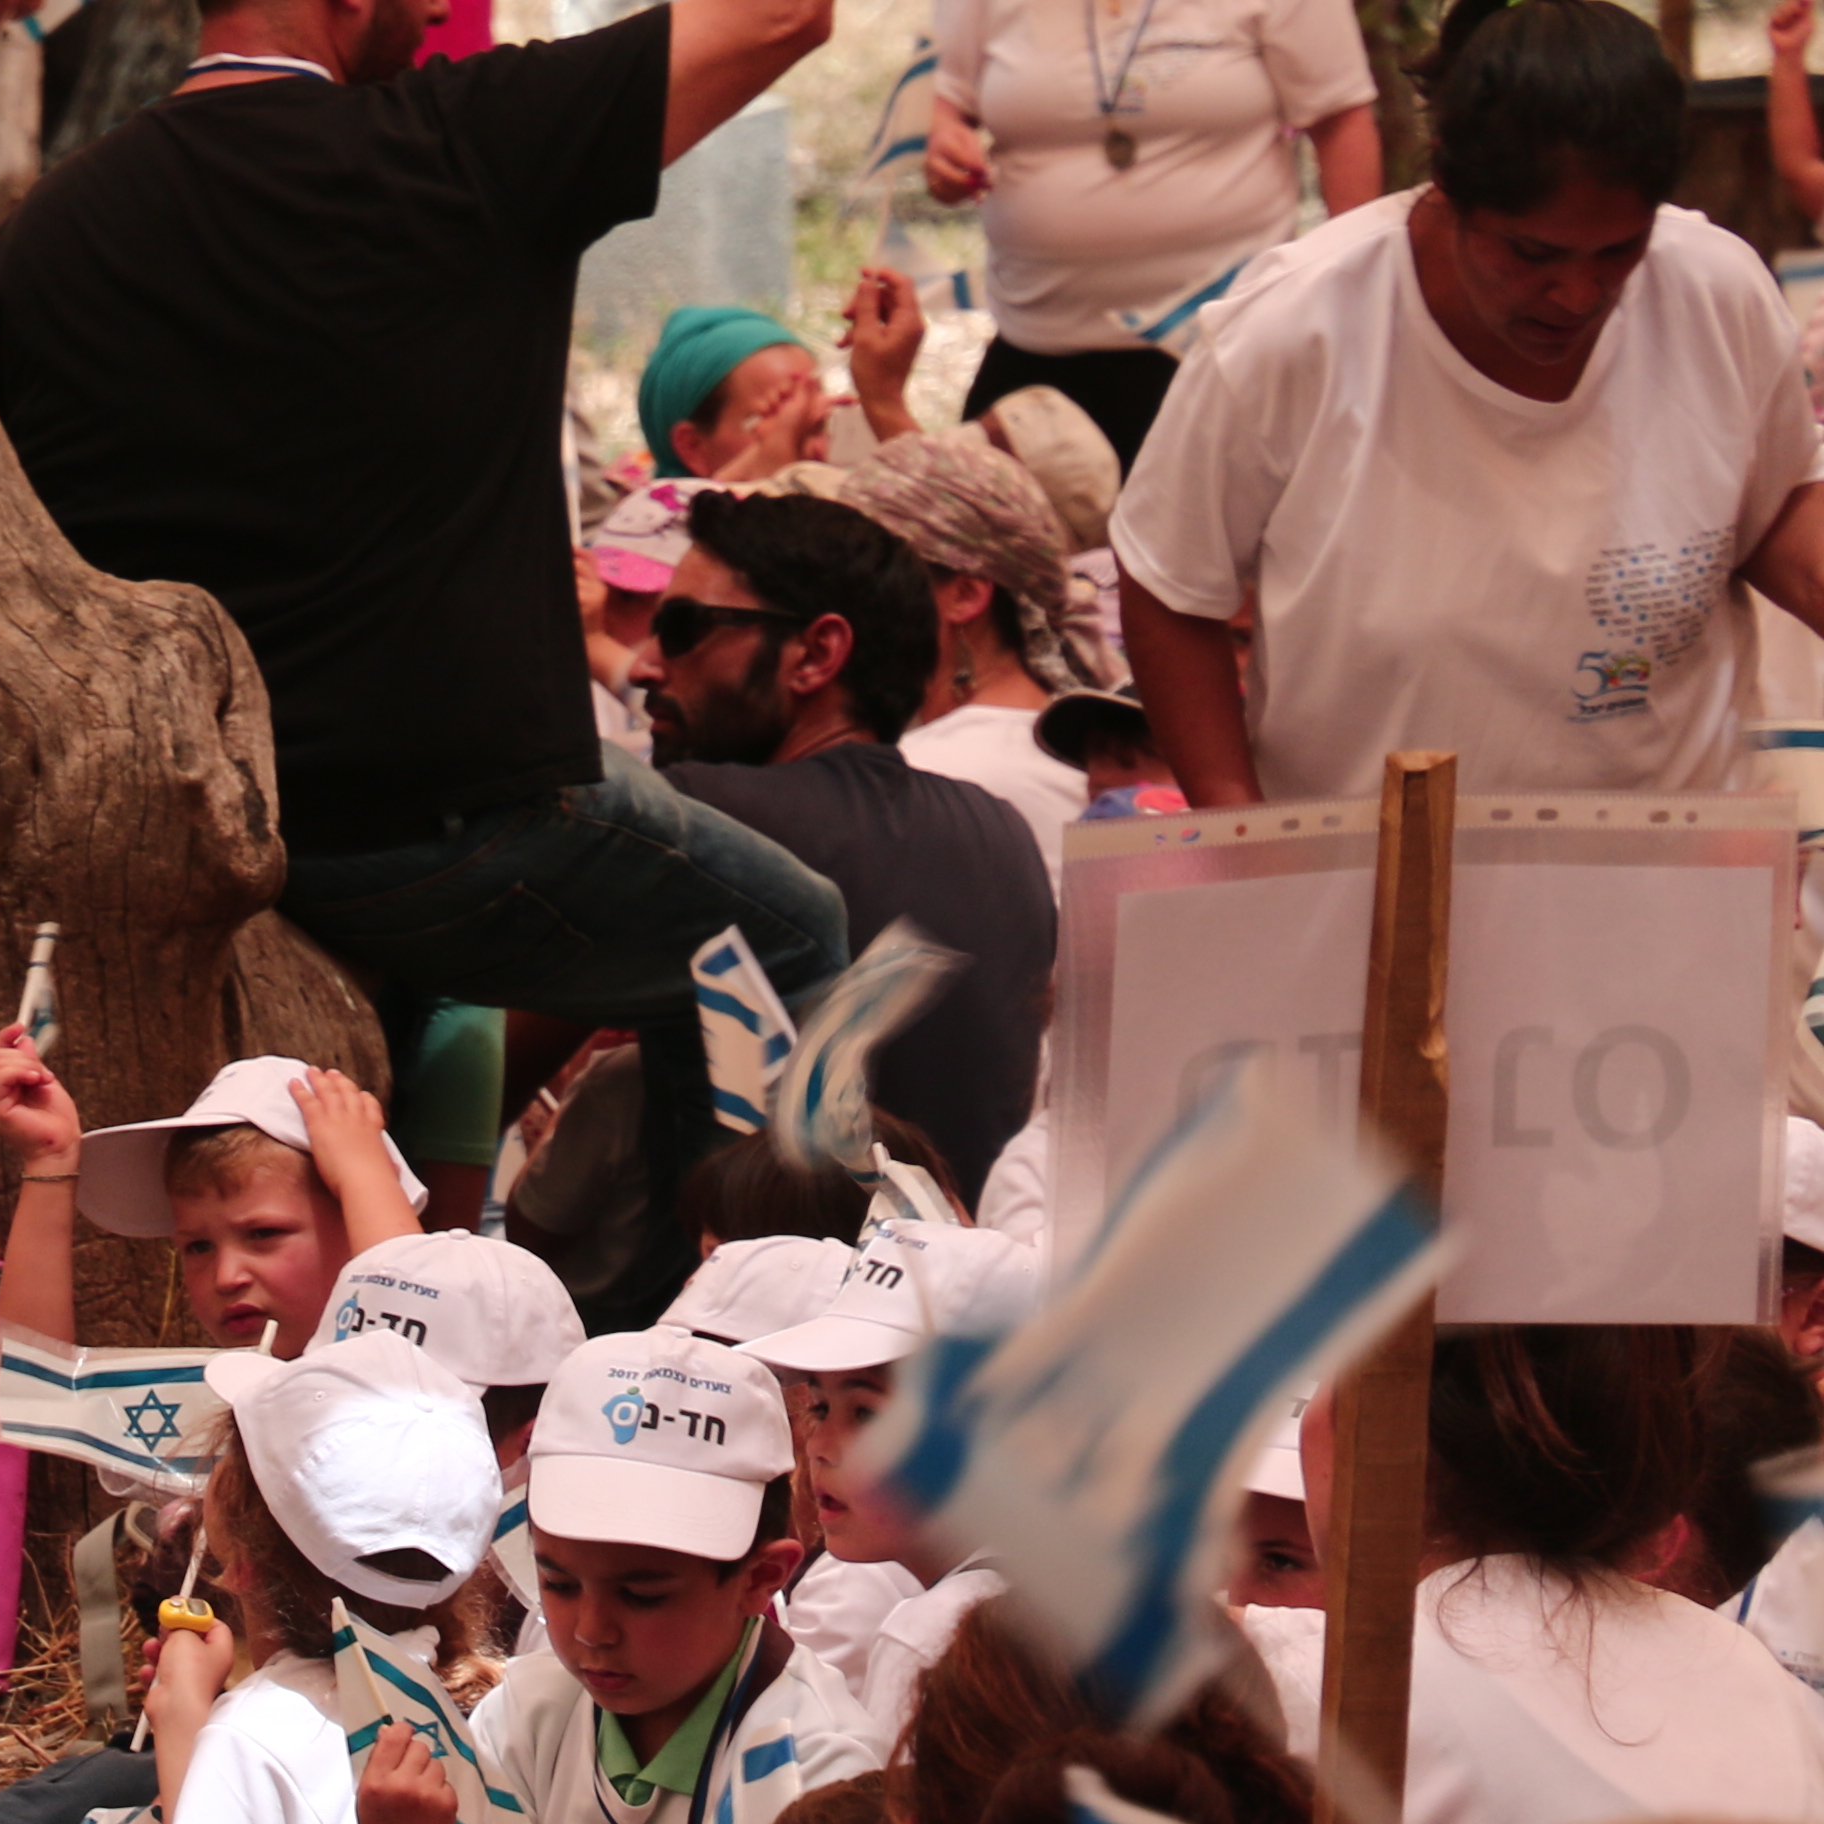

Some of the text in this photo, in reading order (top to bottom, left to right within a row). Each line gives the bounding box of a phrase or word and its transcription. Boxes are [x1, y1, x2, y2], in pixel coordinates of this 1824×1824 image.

[398, 1280, 441, 1300] צועדים
[607, 1367, 640, 1381] 2017
[689, 1377, 733, 1395] צועדים
[610, 1400, 727, 1446] חד-נס
